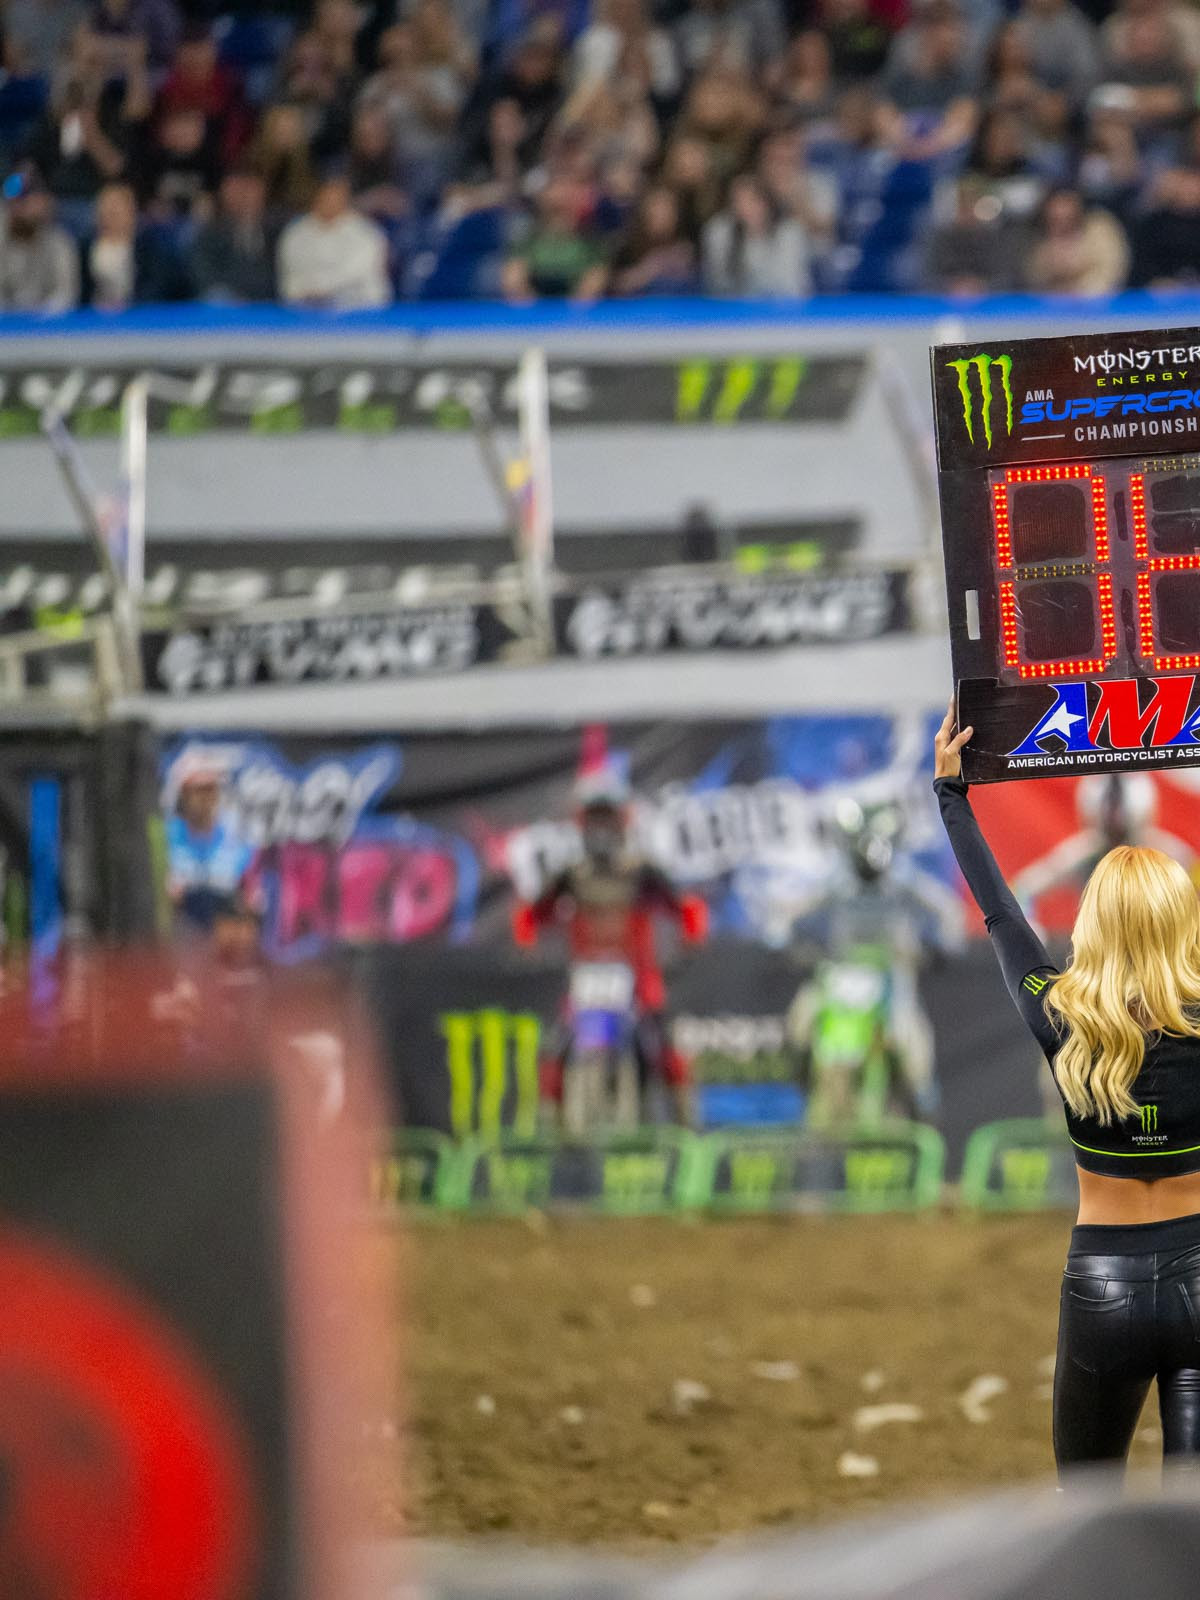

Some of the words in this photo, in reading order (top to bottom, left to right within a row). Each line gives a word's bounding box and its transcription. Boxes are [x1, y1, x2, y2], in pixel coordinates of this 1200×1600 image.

[1096, 370, 1189, 387] ENERGY
[1025, 388, 1054, 402] AMA
[1007, 756, 1074, 769] AMERICAN
[1076, 749, 1174, 764] MOTORCYCLIST
